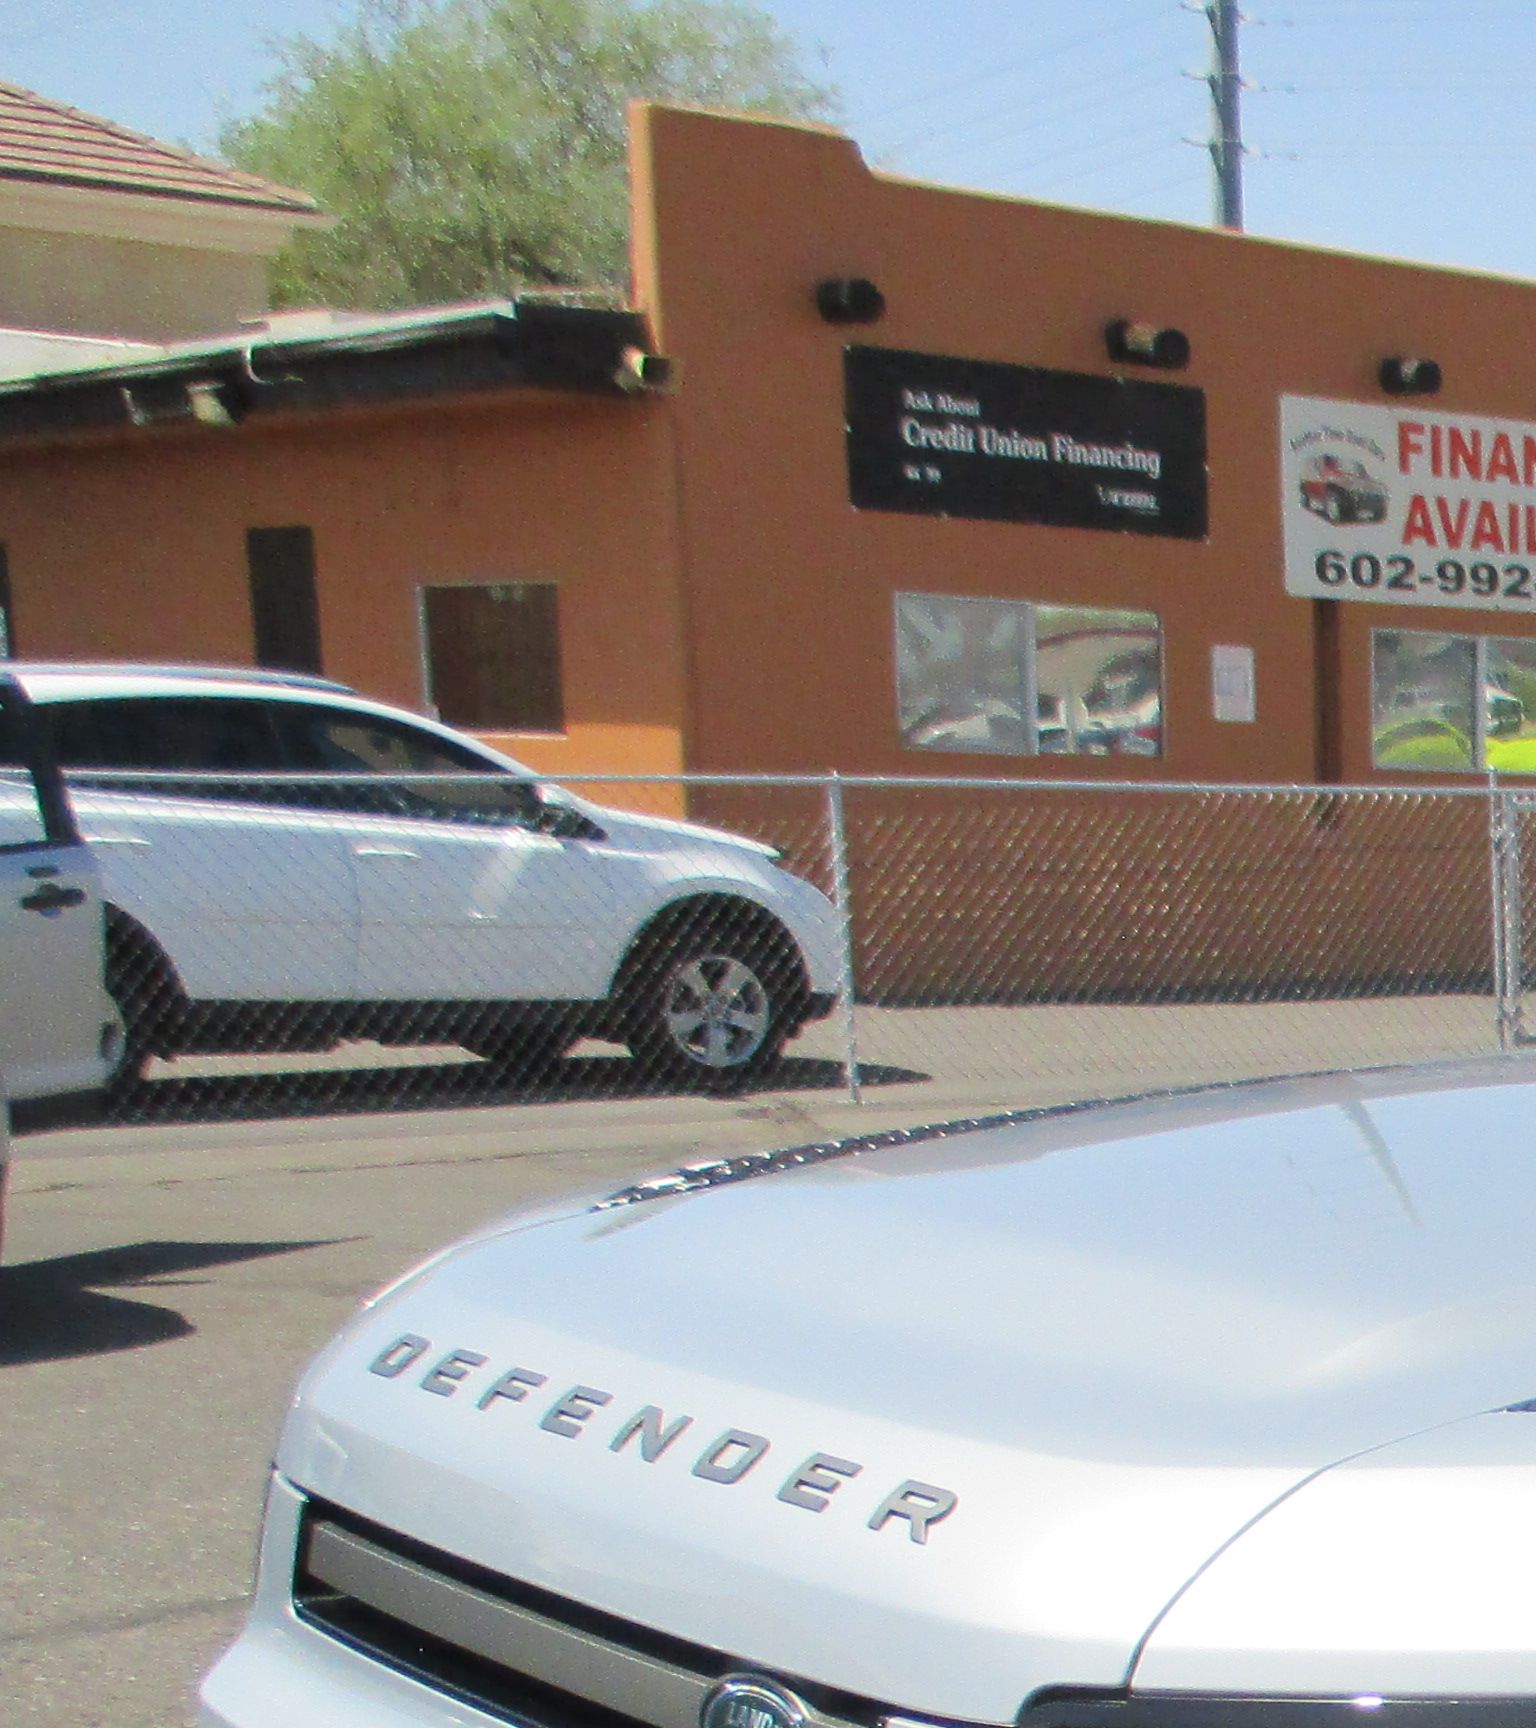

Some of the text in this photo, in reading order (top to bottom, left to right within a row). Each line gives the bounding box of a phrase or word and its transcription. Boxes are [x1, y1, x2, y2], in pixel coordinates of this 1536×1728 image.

[902, 387, 981, 417] Ask About
[901, 416, 1162, 480] Credit Union Financing
[368, 1332, 960, 1546] DEFENDER
